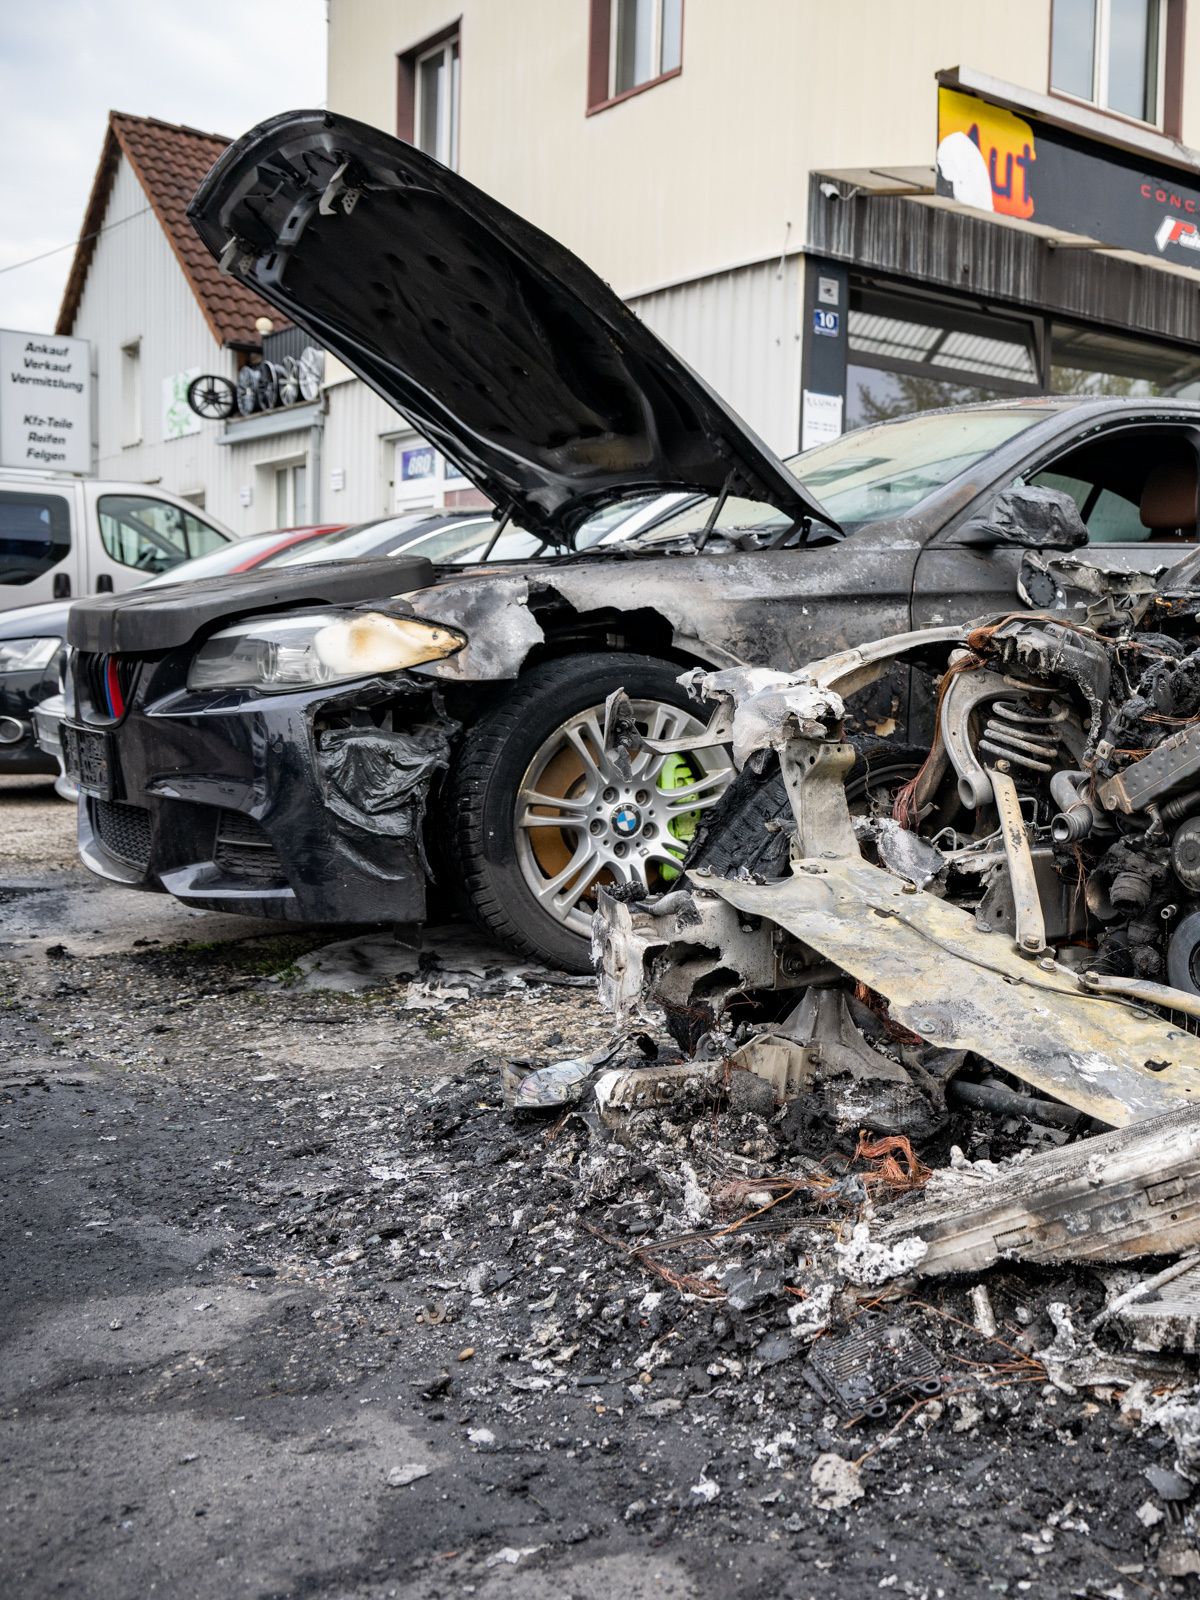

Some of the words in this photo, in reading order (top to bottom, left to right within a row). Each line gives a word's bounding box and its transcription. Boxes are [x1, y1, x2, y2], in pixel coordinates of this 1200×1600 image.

[819, 312, 835, 329] 10
[25, 342, 69, 357] Ankauf
[24, 358, 72, 373] Verkauf
[11, 372, 84, 393] Vermittlung
[23, 415, 73, 429] Kfz-Teile
[28, 431, 66, 445] Reifen
[26, 447, 66, 462] Felgen
